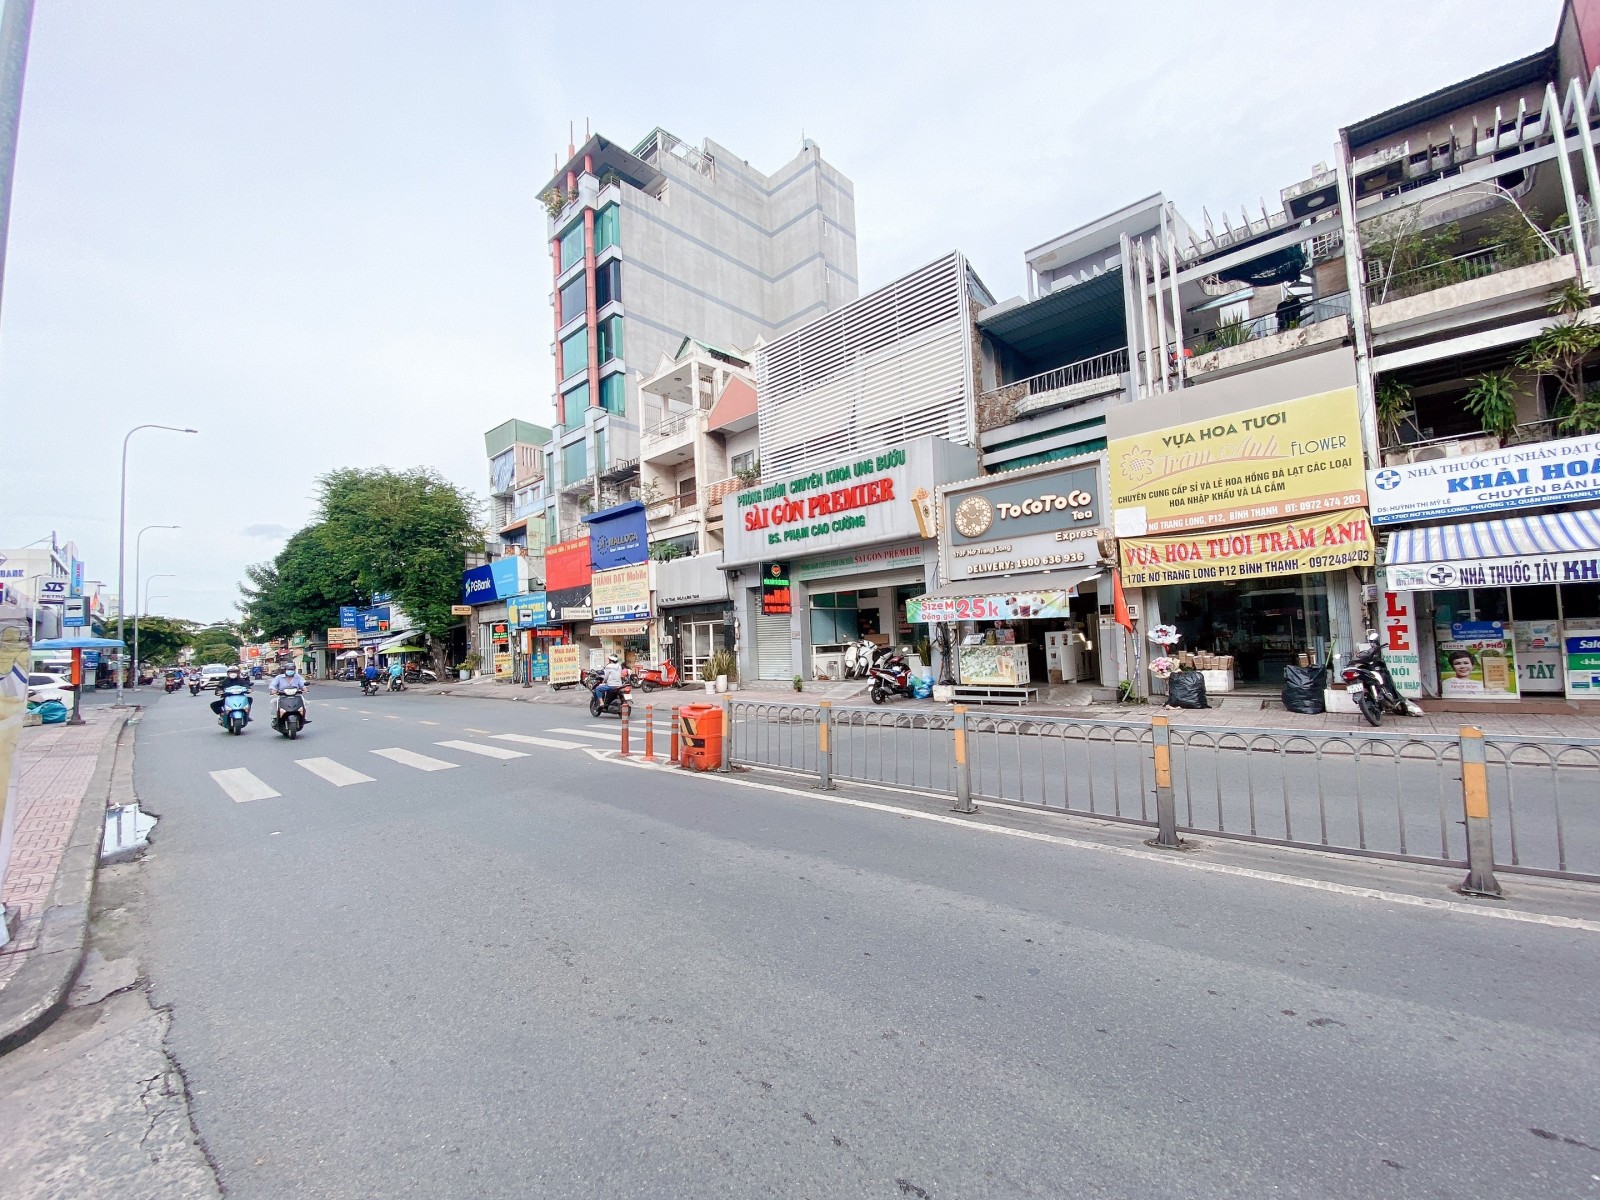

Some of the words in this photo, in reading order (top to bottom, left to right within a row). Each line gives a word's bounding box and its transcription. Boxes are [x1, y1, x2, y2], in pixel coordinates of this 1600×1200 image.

[1162, 432, 1196, 448] VỰA
[1199, 424, 1238, 440] HOA
[1242, 411, 1287, 431] TƯƠI
[1291, 435, 1347, 456] FLOWER
[1407, 465, 1438, 478] NHÀ
[1439, 457, 1489, 474] THUỐC
[1491, 453, 1512, 466] TƯ
[1514, 447, 1557, 463] NHÂN
[1561, 443, 1591, 456] ĐẠT
[737, 490, 761, 507] PHÒNG
[763, 483, 786, 501] KHÁM
[789, 472, 823, 494] CHUYÊN
[826, 465, 851, 485] KHOA
[853, 459, 874, 477] UNG
[876, 449, 906, 471] BƯỚU
[1118, 491, 1146, 504] CHUYÊN
[1148, 488, 1170, 499] CUNG
[1200, 479, 1211, 490] VÀ
[1225, 475, 1242, 487] HOA
[1272, 468, 1285, 479] ĐÀ
[1287, 465, 1304, 477] LẠT
[1307, 461, 1327, 473] CÁC
[1329, 457, 1352, 469] LOẠI
[1478, 485, 1546, 500] CHUYÊN
[1551, 478, 1587, 492] BÁN
[745, 505, 769, 531] SÀI
[771, 497, 805, 525] GÒN
[807, 477, 895, 518] PREMIER
[996, 489, 1092, 520] ToCoToCo
[1169, 499, 1186, 508] HOA
[1187, 493, 1210, 505] NHẬP
[1237, 486, 1249, 497] VÀ
[1071, 509, 1093, 521] Tea
[1160, 520, 1184, 530] TRANG
[1229, 510, 1249, 520] BÌNH
[1251, 506, 1278, 518] THẠNH
[1300, 499, 1321, 511] 0972
[1323, 497, 1341, 508] 474
[1343, 494, 1361, 506] 203
[768, 532, 781, 545] BS.
[784, 527, 809, 542] PHẠM
[811, 523, 830, 537] CAO
[832, 514, 866, 532] CƯỜNG
[1055, 528, 1098, 542] Express
[884, 546, 920, 559] PREMIER
[995, 545, 1012, 554] Long
[1125, 544, 1161, 570] VỰA
[1164, 541, 1203, 562] HOA
[1206, 532, 1253, 559] TƯƠI
[1257, 524, 1316, 553] TRÂM
[1322, 519, 1367, 546] ANH
[967, 561, 1014, 574] DELIVERY:
[1016, 557, 1040, 568] 1900
[1042, 554, 1062, 565] 636
[1064, 552, 1085, 562] 936
[1163, 569, 1190, 580] TRANG
[1193, 567, 1216, 579] LONG
[1219, 566, 1237, 576] P12
[1239, 561, 1262, 575] BÌNH
[1265, 559, 1299, 573] THẠNH
[1459, 560, 1486, 585] NHÀ
[1489, 559, 1531, 584] THUỐC
[1534, 558, 1558, 581] TÂY
[41, 582, 68, 592] STS
[470, 578, 491, 592] PGBank
[921, 601, 944, 612] Size
[944, 599, 955, 611] M
[1526, 660, 1556, 679] TÂY
